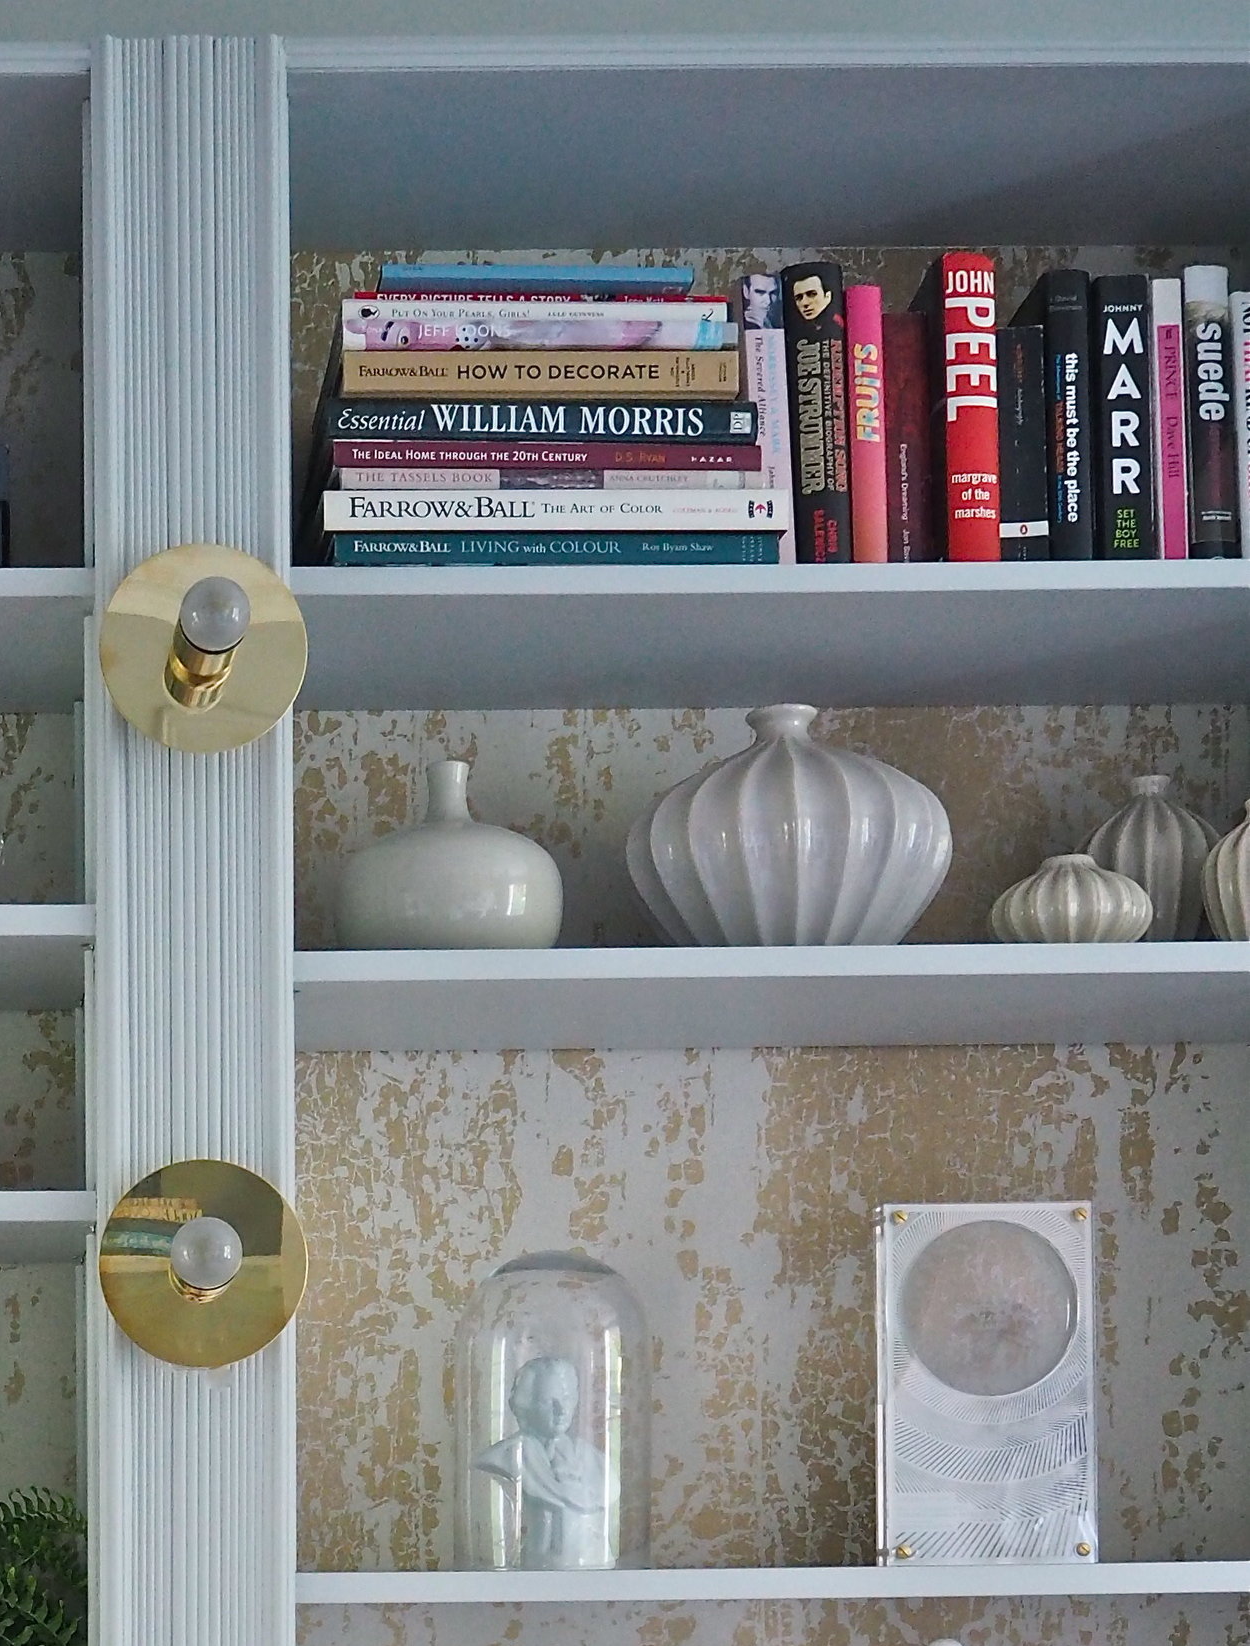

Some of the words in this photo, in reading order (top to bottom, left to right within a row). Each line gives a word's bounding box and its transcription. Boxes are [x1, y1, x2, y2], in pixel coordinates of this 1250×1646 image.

[947, 270, 995, 296] JOHN
[391, 308, 409, 317] PUT
[413, 308, 428, 317] ON
[431, 308, 454, 317] YOUR
[1103, 303, 1143, 313] JOHNNY
[418, 325, 450, 338] JEFF
[796, 338, 822, 376] JOE
[946, 297, 998, 423] PEEL
[1065, 352, 1078, 382] this
[457, 365, 507, 379] HOW
[514, 365, 541, 379] TO
[549, 365, 660, 379] DECORATE
[756, 357, 765, 392] Severed
[1162, 346, 1178, 399] PRINCE
[1196, 321, 1230, 422] suede
[823, 356, 832, 416] DEFINITIVE
[757, 395, 767, 436] Alliance
[1066, 385, 1079, 425] must
[1103, 317, 1144, 494] MARR
[338, 408, 426, 432] Essential
[430, 404, 566, 435] WILLIAM
[579, 406, 704, 437] MORRIS
[797, 378, 827, 495] STRUMMER
[1067, 427, 1081, 448] be
[1165, 416, 1181, 450] Dave
[352, 449, 370, 459] THE
[374, 449, 402, 460] IDEAL
[405, 449, 436, 460] HOME
[440, 451, 487, 461] THROUGH
[491, 451, 509, 461] THE
[513, 451, 538, 461] 20TH
[541, 451, 588, 462] CENTURY
[639, 452, 666, 463] RYAN
[825, 418, 835, 476] BIOGRAPHY
[835, 450, 848, 493] SONG
[1067, 450, 1081, 477] the
[1167, 454, 1180, 479] Hill
[356, 472, 384, 483] THE
[391, 472, 447, 483] TASSELS
[452, 472, 492, 483] BOOK
[827, 478, 835, 491] OF
[951, 473, 998, 485] margrave
[961, 488, 972, 501] of
[974, 488, 990, 501] the
[1064, 479, 1080, 523] place
[541, 503, 566, 515] THE
[570, 503, 594, 515] ART
[600, 504, 615, 515] OF
[620, 503, 663, 515] COLOR
[955, 505, 996, 519] marshes
[1117, 509, 1136, 519] SET
[1115, 529, 1137, 539] BOY
[1116, 520, 1137, 529] THE
[461, 541, 519, 554] LIVING
[523, 543, 546, 554] with
[550, 541, 622, 554] COLOUR
[690, 543, 714, 552] Shaw
[1114, 539, 1139, 549] FREE
